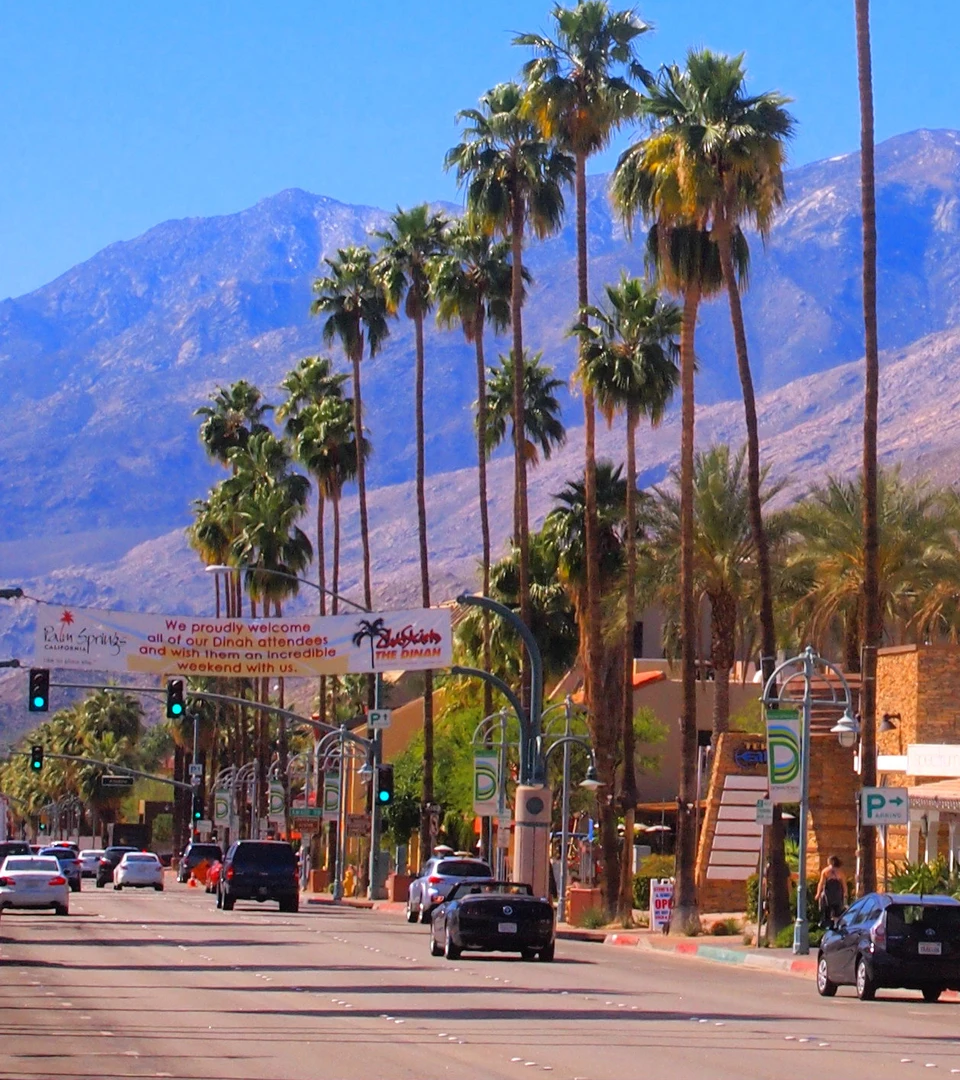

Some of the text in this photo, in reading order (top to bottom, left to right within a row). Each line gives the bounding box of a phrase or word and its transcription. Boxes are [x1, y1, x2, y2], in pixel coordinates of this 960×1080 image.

[165, 620, 311, 634] We proudly welcome
[147, 633, 329, 648] all of our Dinah attendees
[44, 644, 87, 652] CALIFORNIA
[139, 646, 336, 660] and wish them an incredible
[376, 648, 442, 660] THE DINAH
[177, 662, 297, 673] weekend with us.
[371, 713, 381, 725] P
